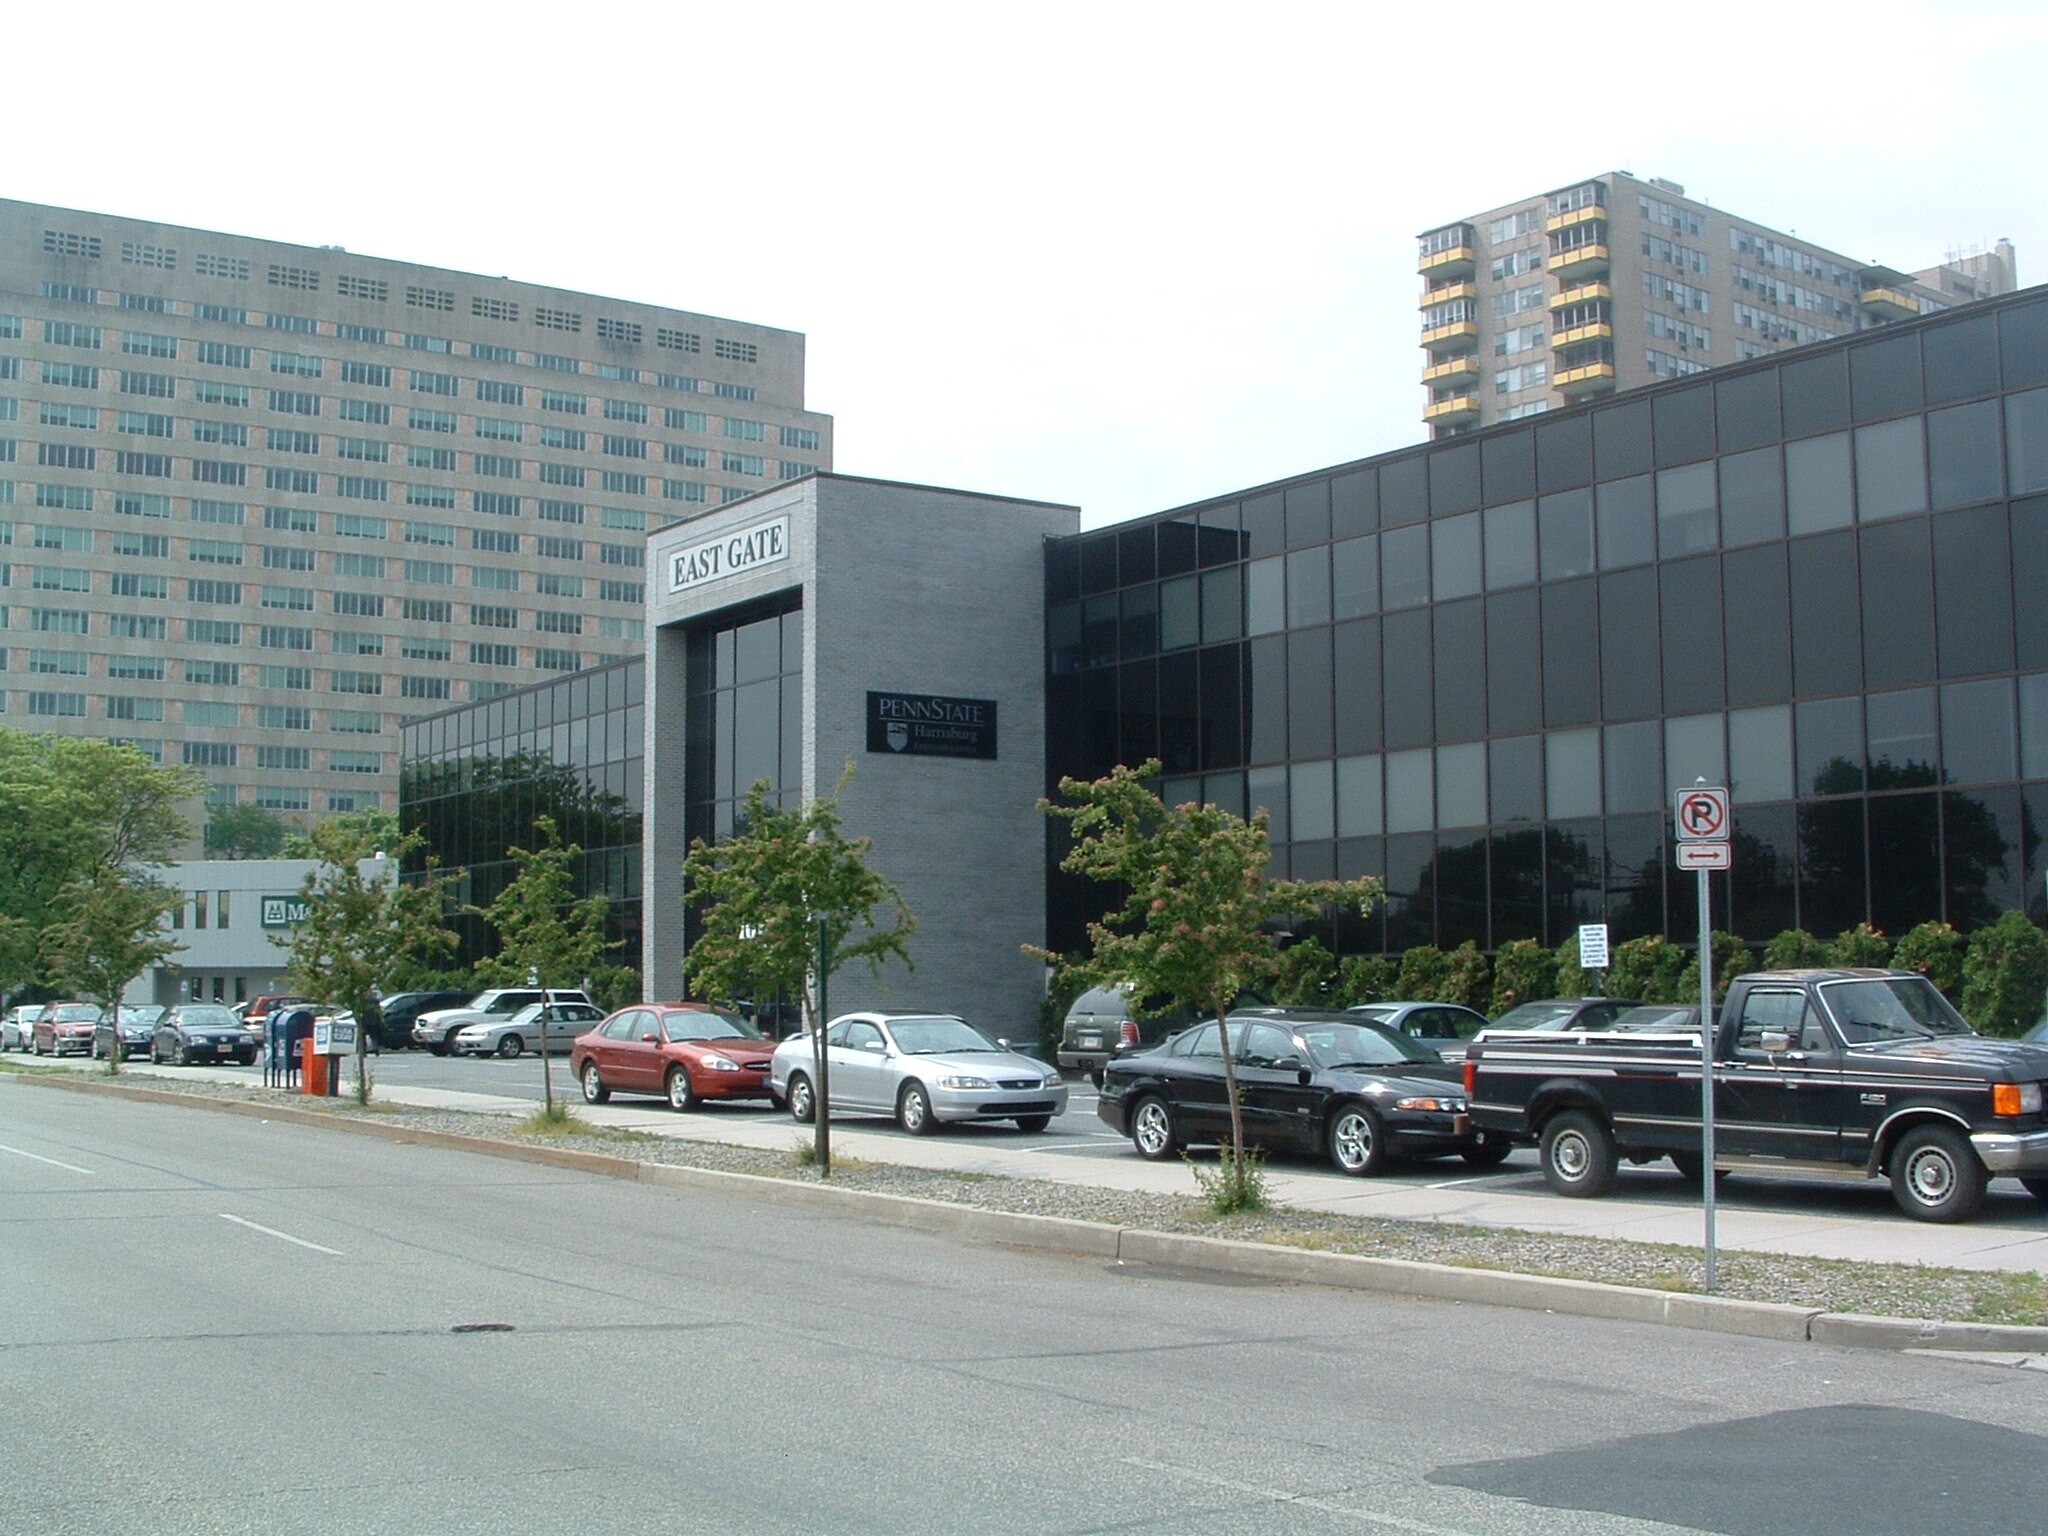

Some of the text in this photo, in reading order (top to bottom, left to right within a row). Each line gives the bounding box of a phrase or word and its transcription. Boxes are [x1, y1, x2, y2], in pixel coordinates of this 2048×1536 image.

[674, 524, 783, 587] EAST GATE
[287, 903, 312, 920] M&
